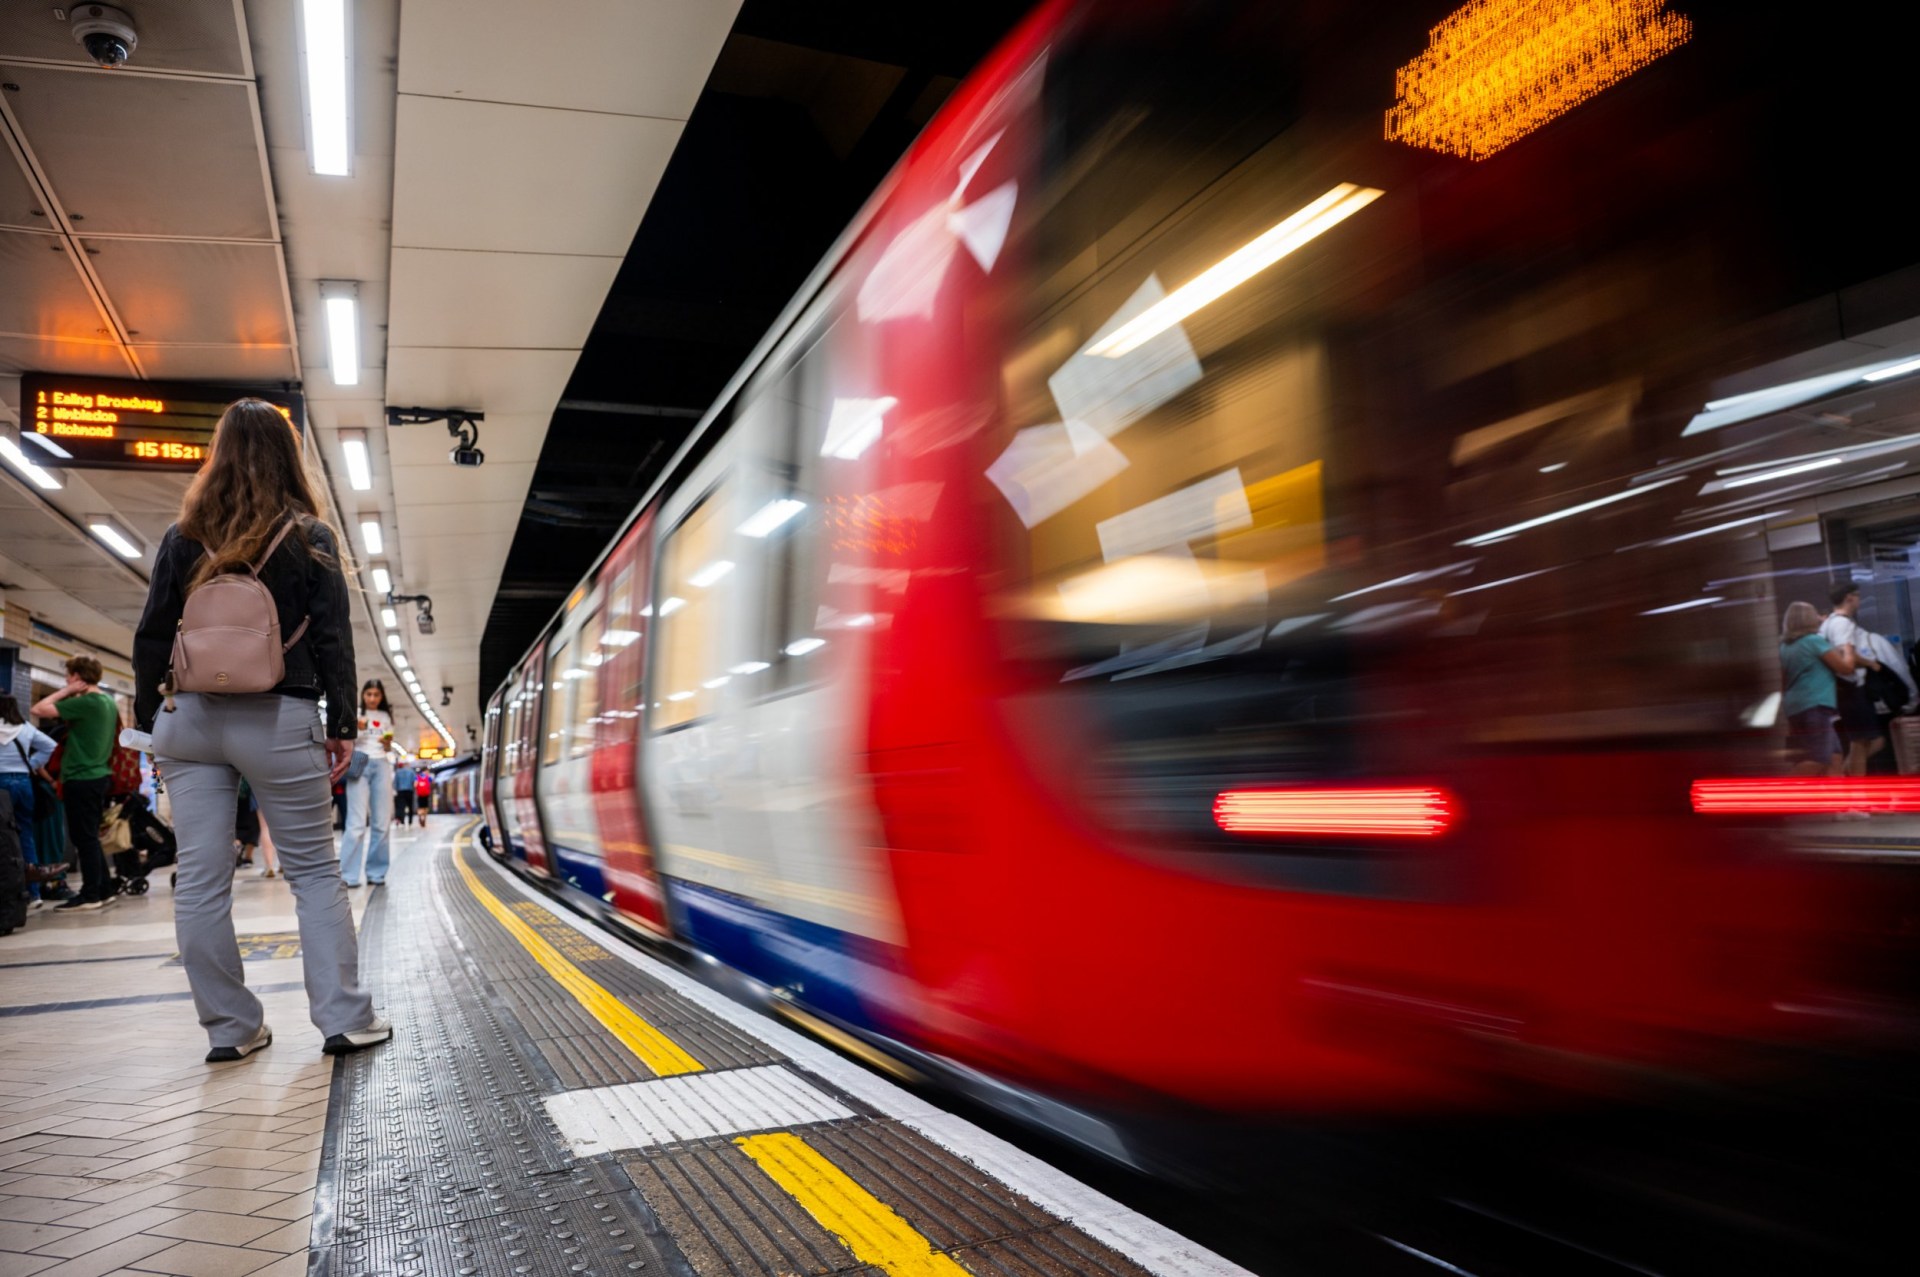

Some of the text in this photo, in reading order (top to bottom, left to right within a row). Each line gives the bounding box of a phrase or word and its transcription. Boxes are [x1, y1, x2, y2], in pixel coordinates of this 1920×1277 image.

[38, 391, 163, 413] 1 Ealing Broadway
[37, 407, 117, 422] 2 Wimbledon
[37, 422, 113, 437] 3 Richmond
